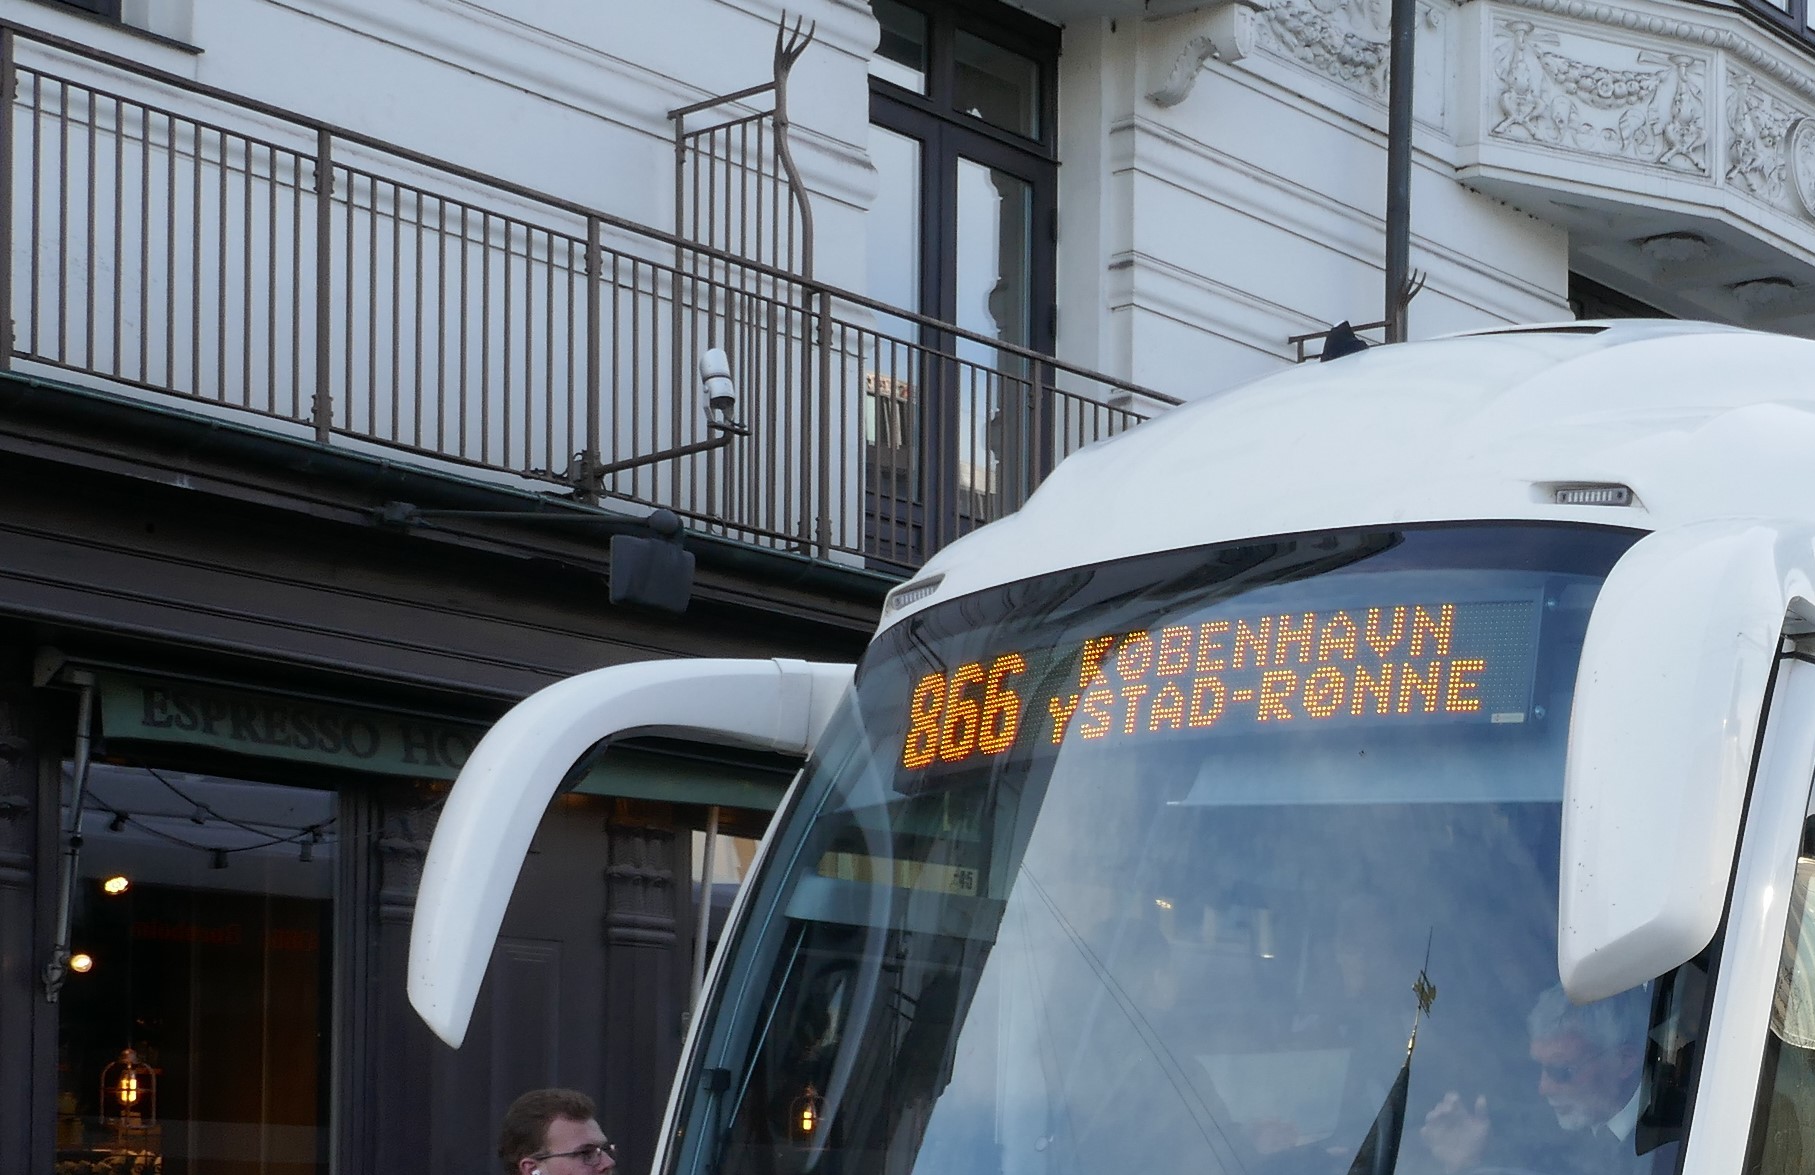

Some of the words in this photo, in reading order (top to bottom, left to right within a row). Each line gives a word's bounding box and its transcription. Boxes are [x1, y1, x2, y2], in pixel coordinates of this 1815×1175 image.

[1079, 603, 1457, 689] KØBENHAVN
[139, 686, 381, 759] ESPRESSO
[902, 653, 1025, 770] 866
[1047, 658, 1487, 745] YSTAD-RØNNE
